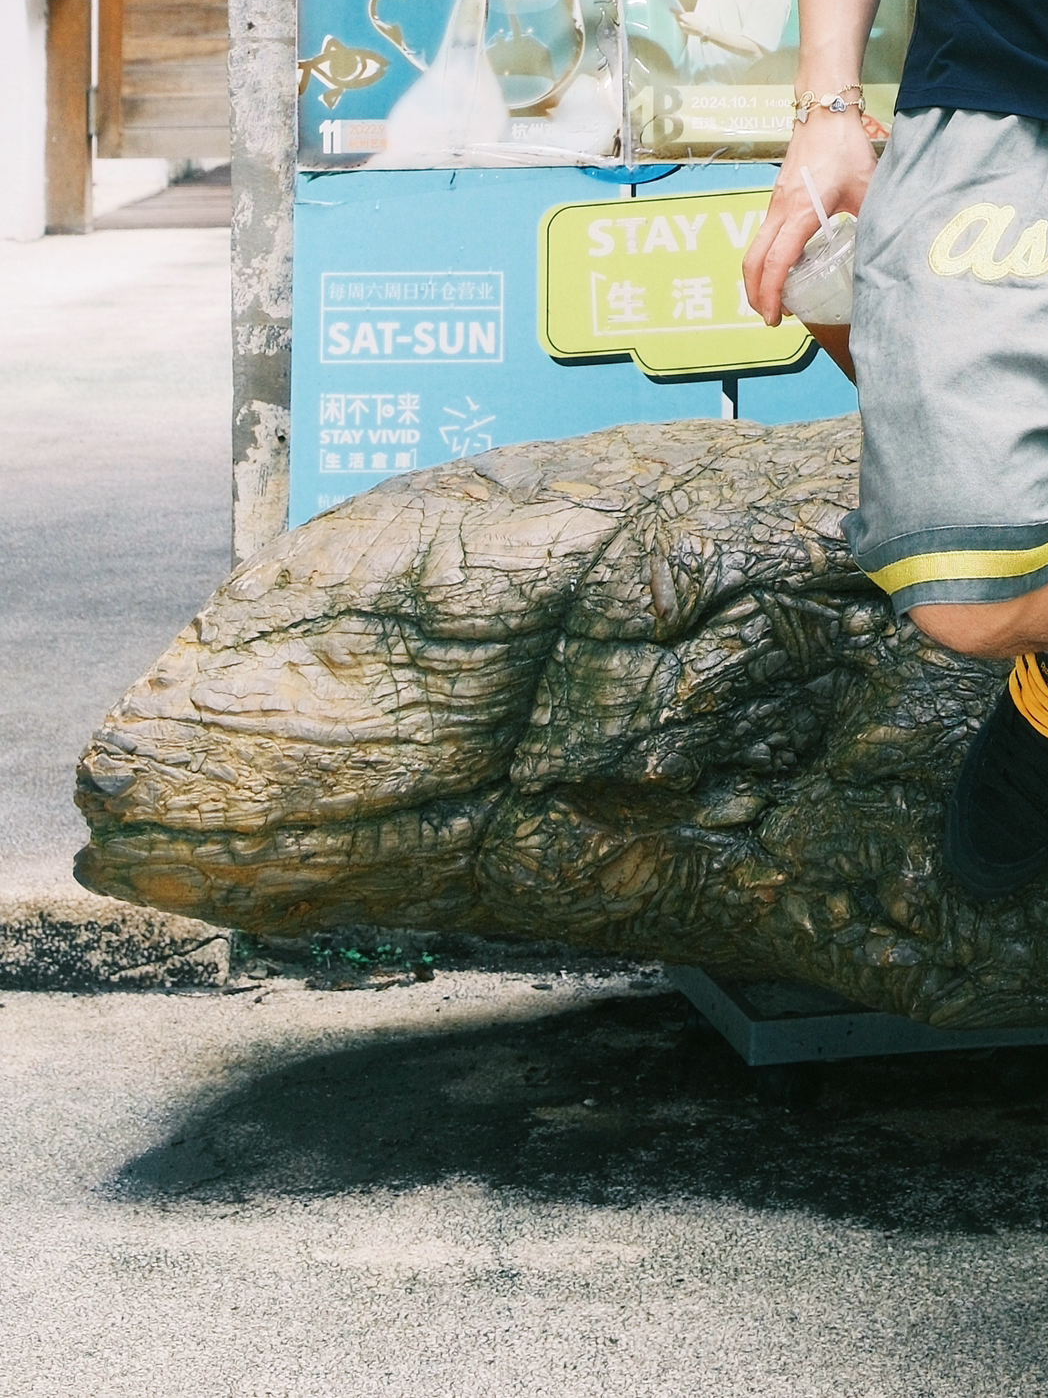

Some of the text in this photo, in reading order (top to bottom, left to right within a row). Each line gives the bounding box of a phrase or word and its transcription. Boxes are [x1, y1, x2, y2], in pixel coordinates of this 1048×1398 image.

[691, 96, 790, 109] 2024.10.1 14:00
[319, 120, 342, 153] 11
[587, 213, 708, 257] STAY
[328, 282, 494, 301] 每周六周日开仓营业
[328, 321, 496, 355] SAT-SUN
[320, 429, 420, 444] STAY VIVID
